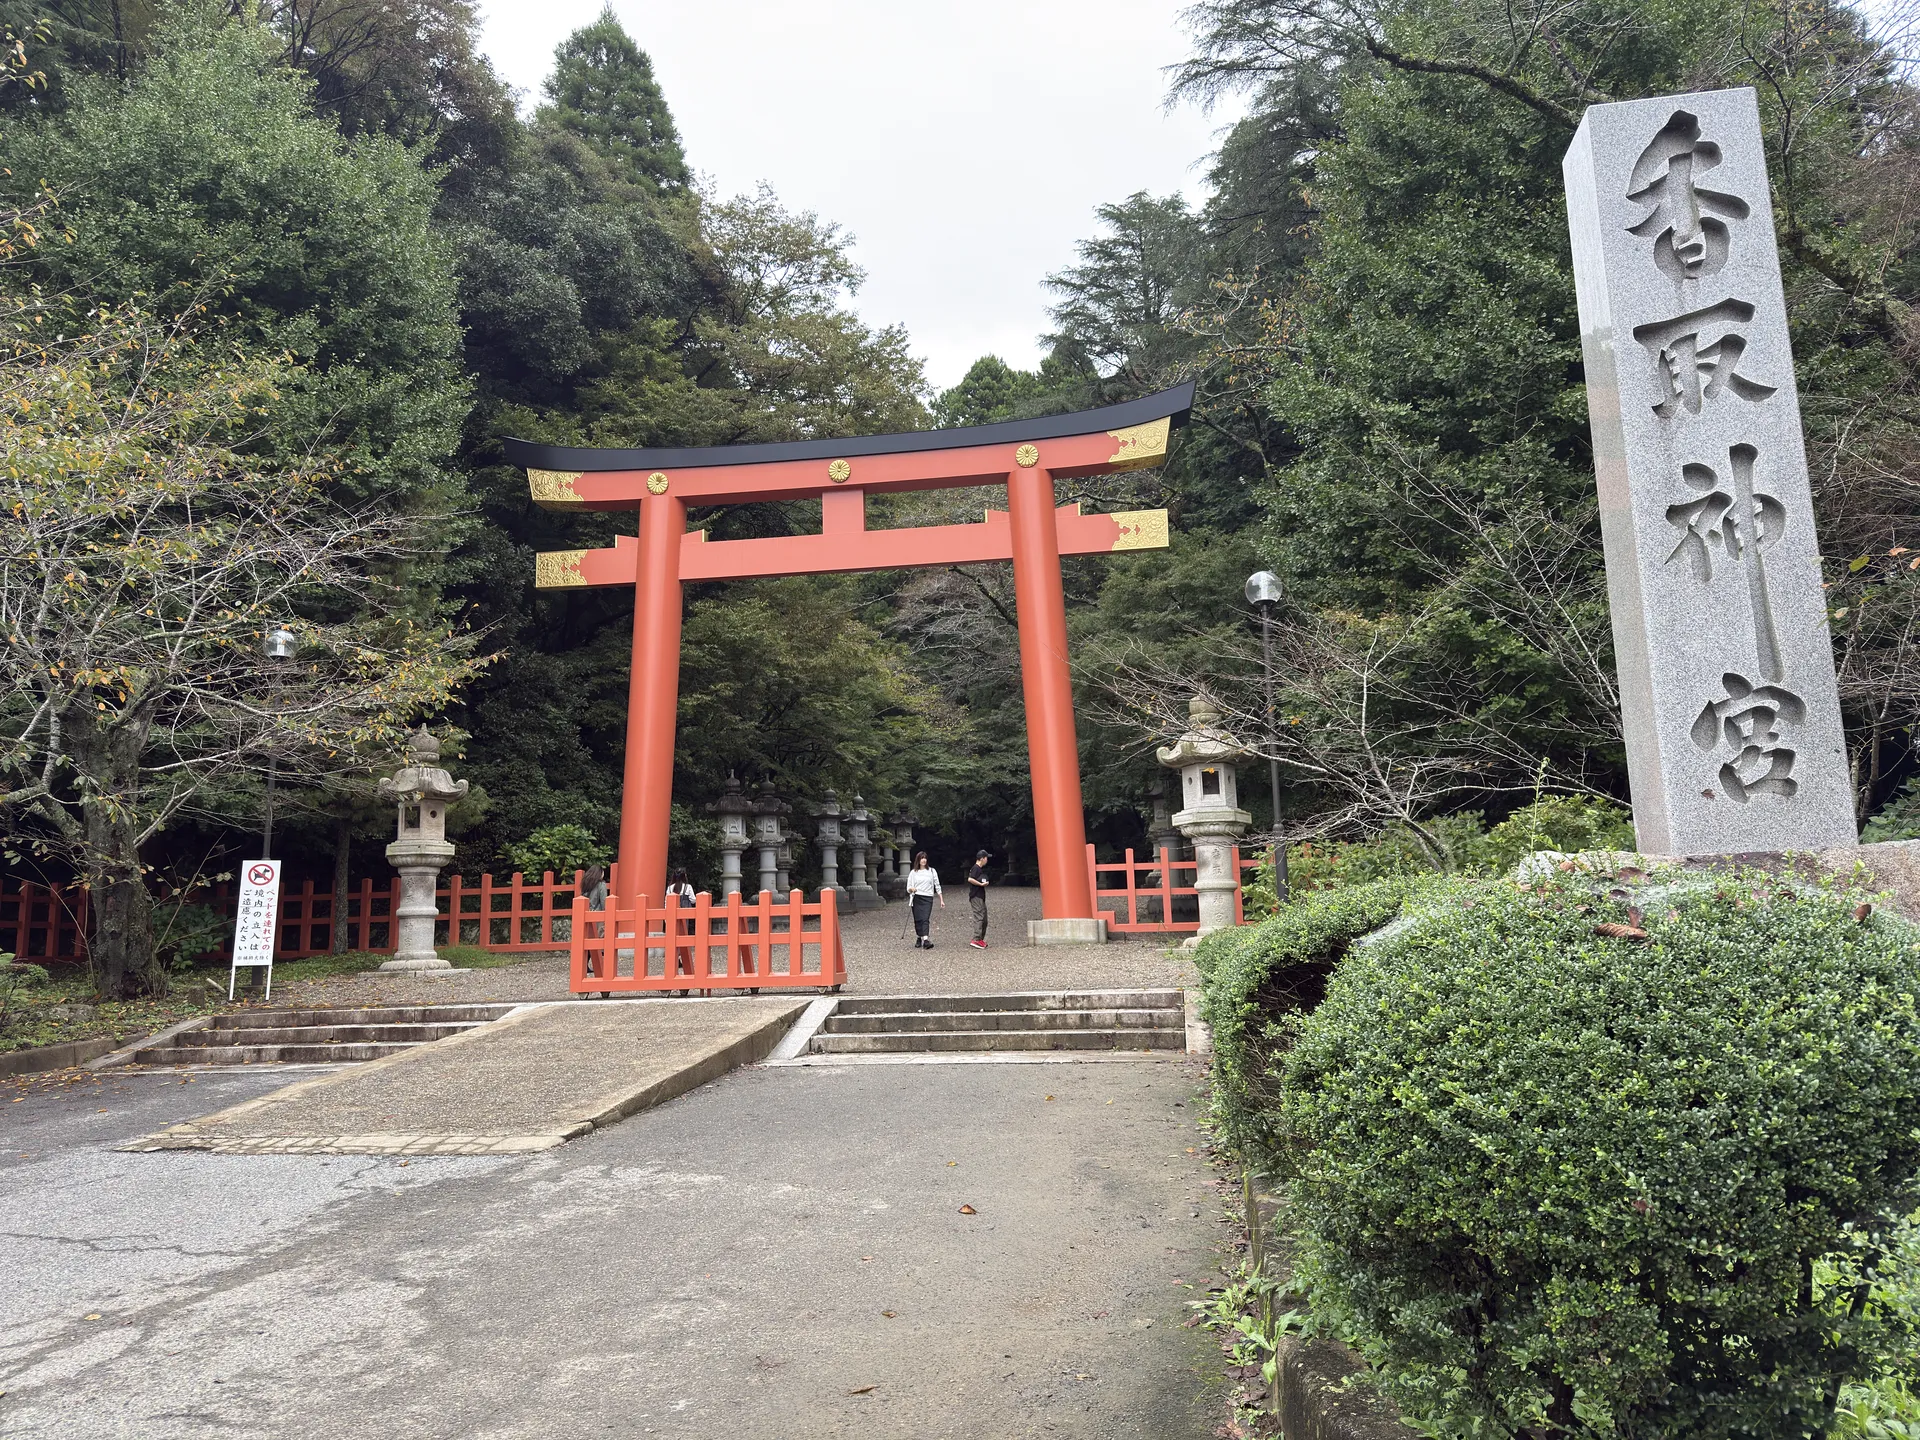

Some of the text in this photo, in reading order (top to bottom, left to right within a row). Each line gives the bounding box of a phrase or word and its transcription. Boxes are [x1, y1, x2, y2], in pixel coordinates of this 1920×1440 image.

[1625, 109, 1807, 802] 香取神宮
[238, 888, 252, 951] ご遠慮ください
[250, 888, 265, 951] 境内の立入は
[261, 888, 275, 951] ペットを連れての
